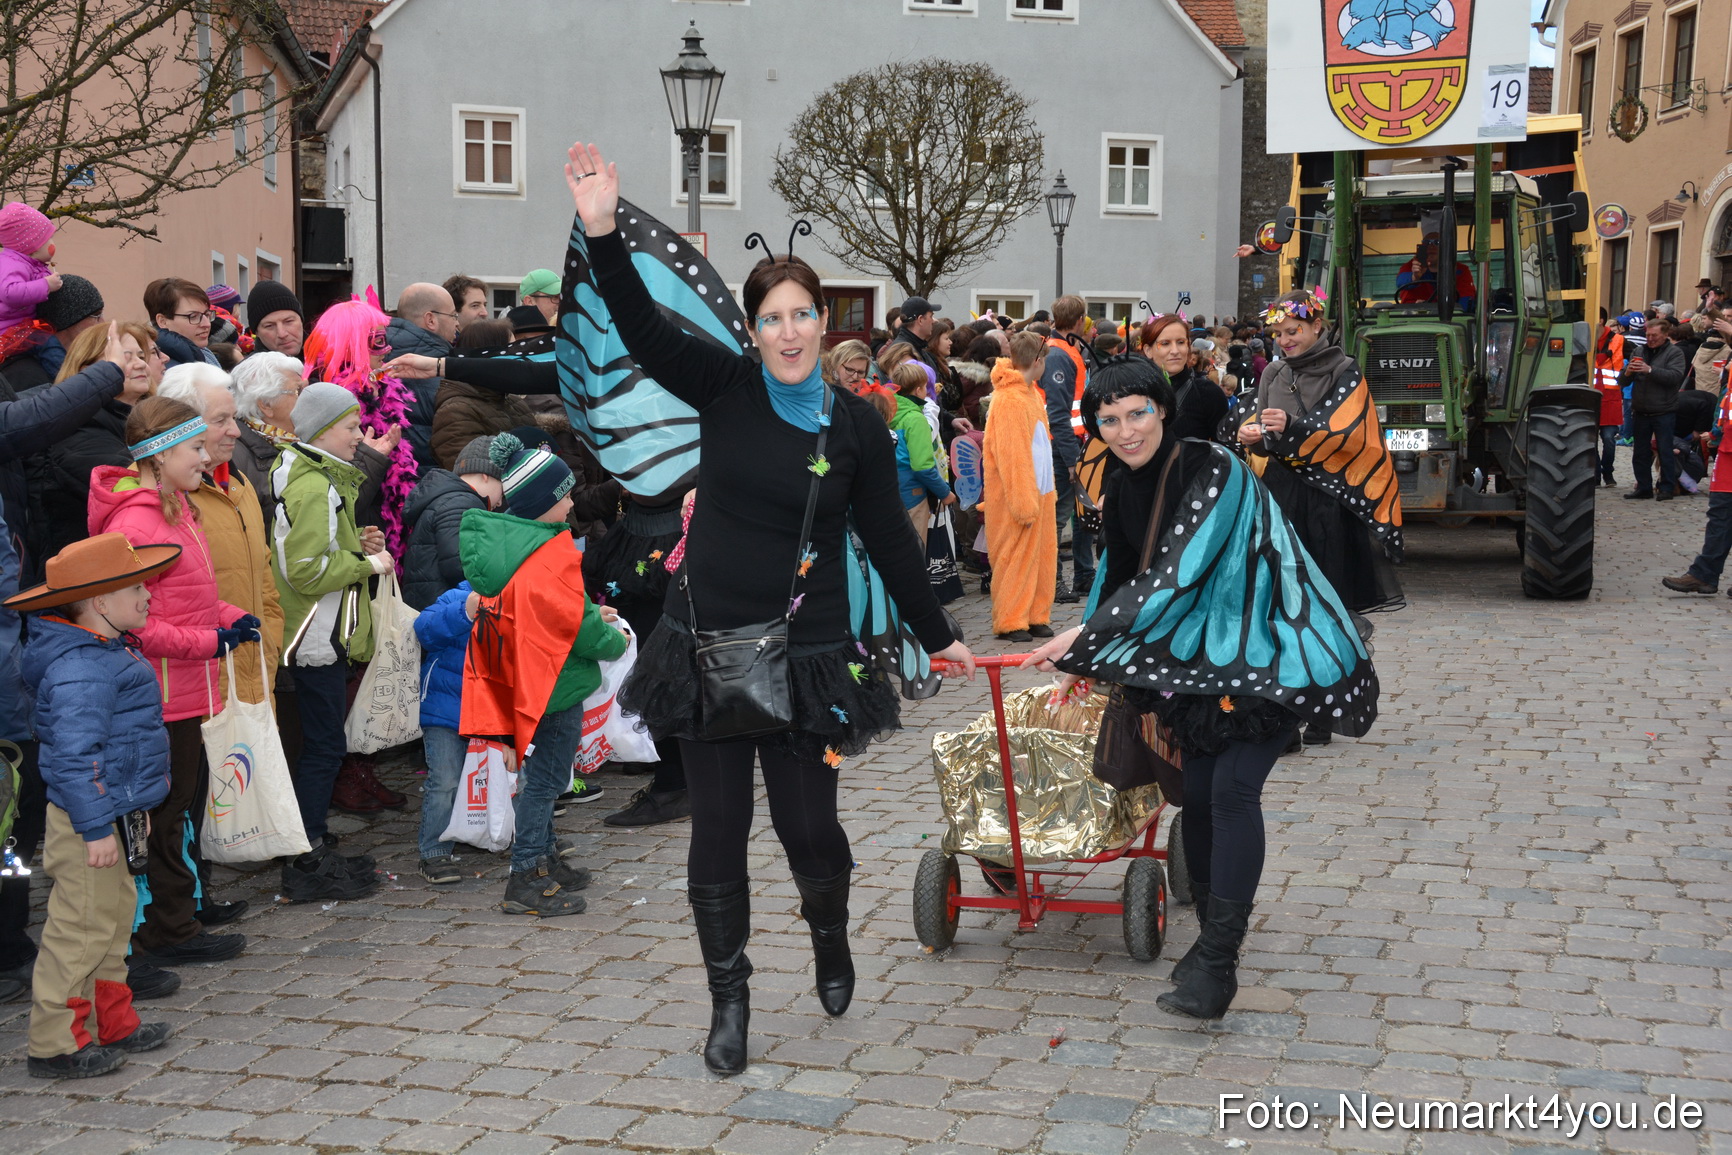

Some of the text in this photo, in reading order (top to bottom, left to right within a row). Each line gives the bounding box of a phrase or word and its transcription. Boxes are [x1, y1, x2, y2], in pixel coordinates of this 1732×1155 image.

[1490, 79, 1522, 109] 19
[1379, 358, 1434, 369] FENDT
[1395, 430, 1410, 439] NM
[1391, 440, 1419, 450] MM 66
[207, 825, 260, 846] DELPHI
